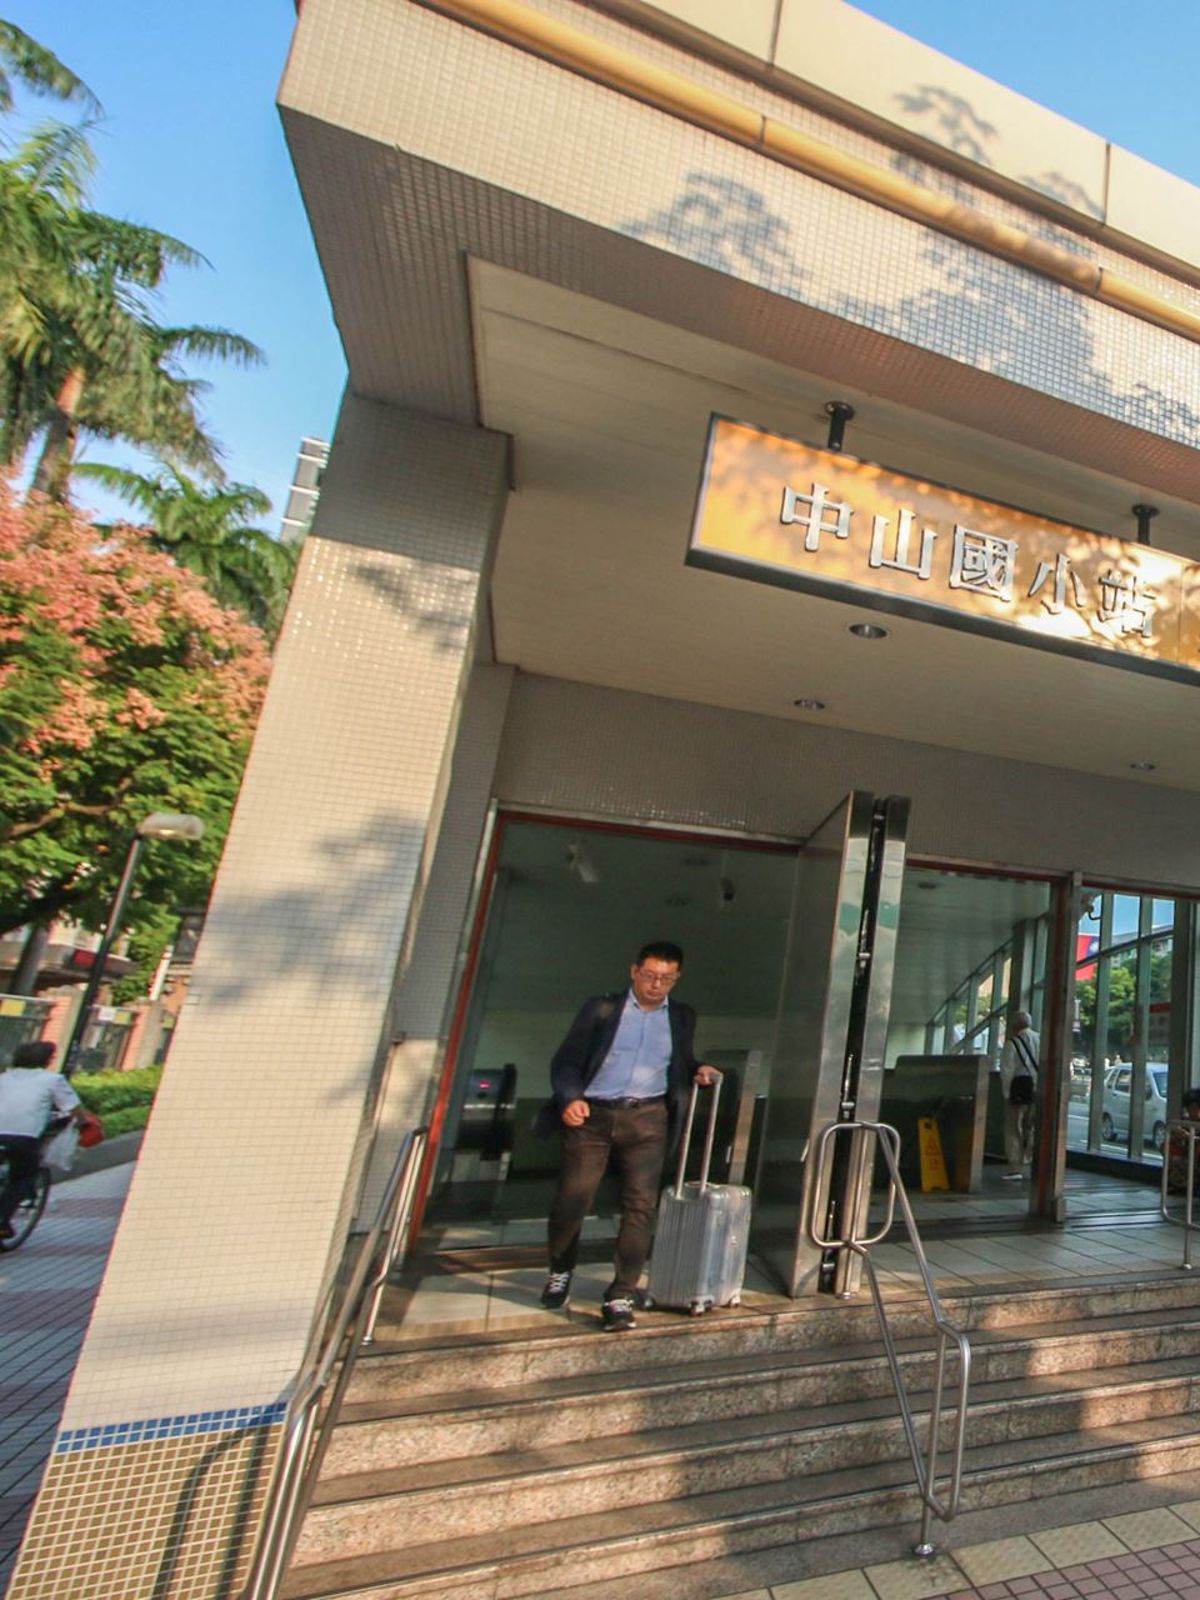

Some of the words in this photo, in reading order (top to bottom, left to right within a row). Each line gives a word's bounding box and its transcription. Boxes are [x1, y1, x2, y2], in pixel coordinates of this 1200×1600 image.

[780, 482, 1157, 638] 中山國小站
